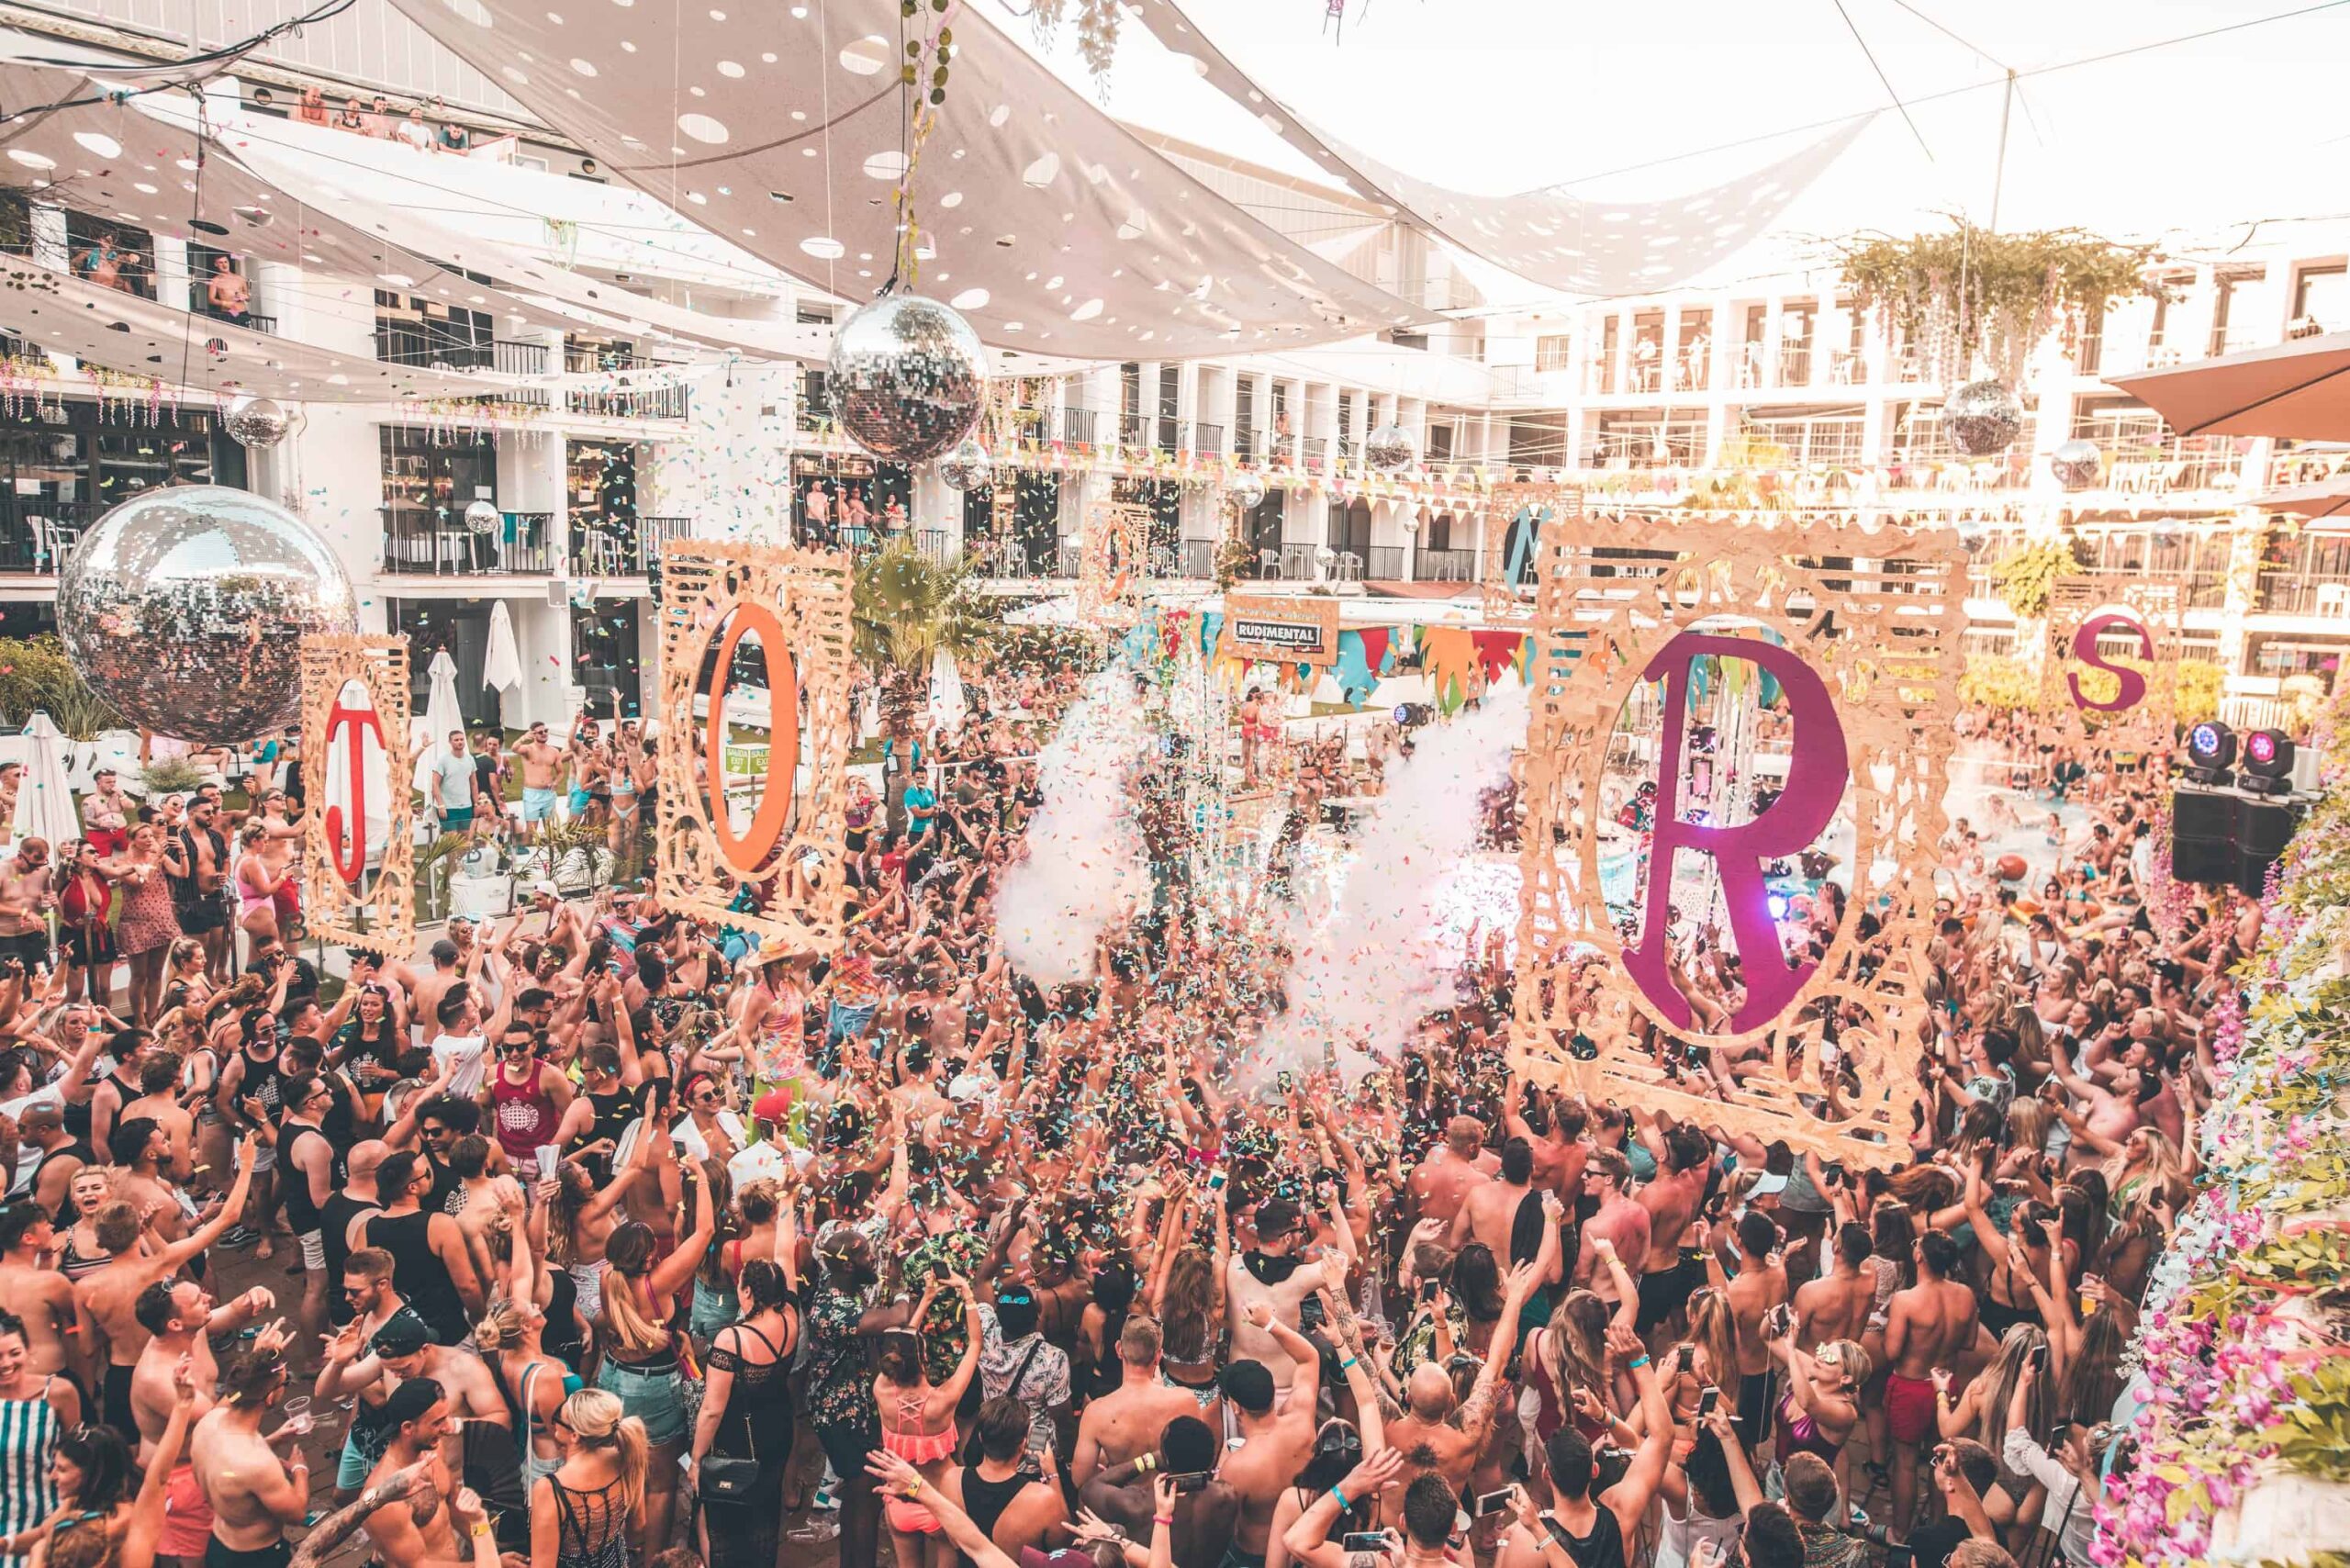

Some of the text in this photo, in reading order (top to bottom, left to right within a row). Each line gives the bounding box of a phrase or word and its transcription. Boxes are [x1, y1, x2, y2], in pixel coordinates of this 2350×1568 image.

[1238, 624, 1315, 641] RUDIMENTAL
[2067, 614, 2154, 711] S
[1621, 631, 1848, 1035] R
